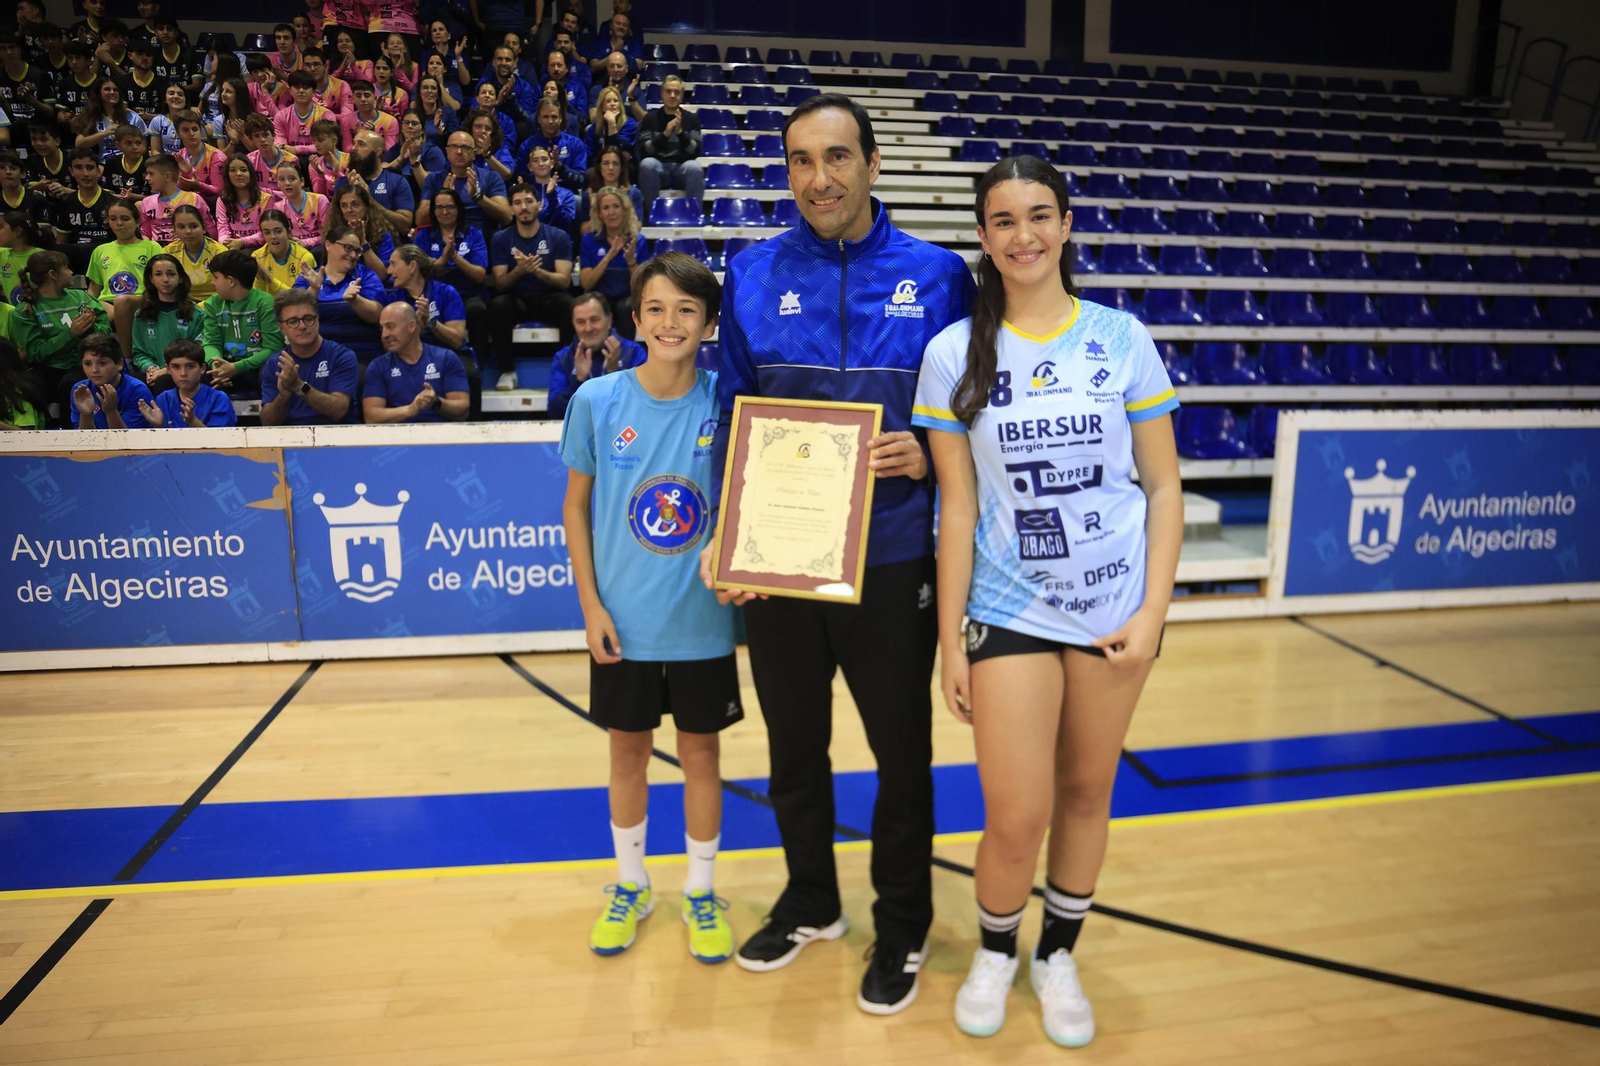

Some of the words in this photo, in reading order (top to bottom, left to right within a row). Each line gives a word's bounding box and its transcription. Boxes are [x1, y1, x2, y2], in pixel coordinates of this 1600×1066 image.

[156, 66, 166, 77] 53
[998, 414, 1103, 442] IBERSUR
[1000, 440, 1043, 453] Energía
[1046, 467, 1089, 483] DYPRE
[1418, 490, 1576, 524] Ayuntamiento
[11, 530, 245, 568] Ayuntamiento
[425, 521, 566, 556] Ayuntam
[1021, 535, 1064, 557] UBAGO
[1415, 532, 1441, 555] de
[1446, 524, 1557, 558] Algeciras
[428, 567, 461, 591] de
[472, 557, 574, 595] Algeci
[1045, 580, 1074, 592] FRS
[1084, 558, 1130, 587] DFDS
[16, 580, 52, 603] de
[64, 570, 229, 608] Algeciras
